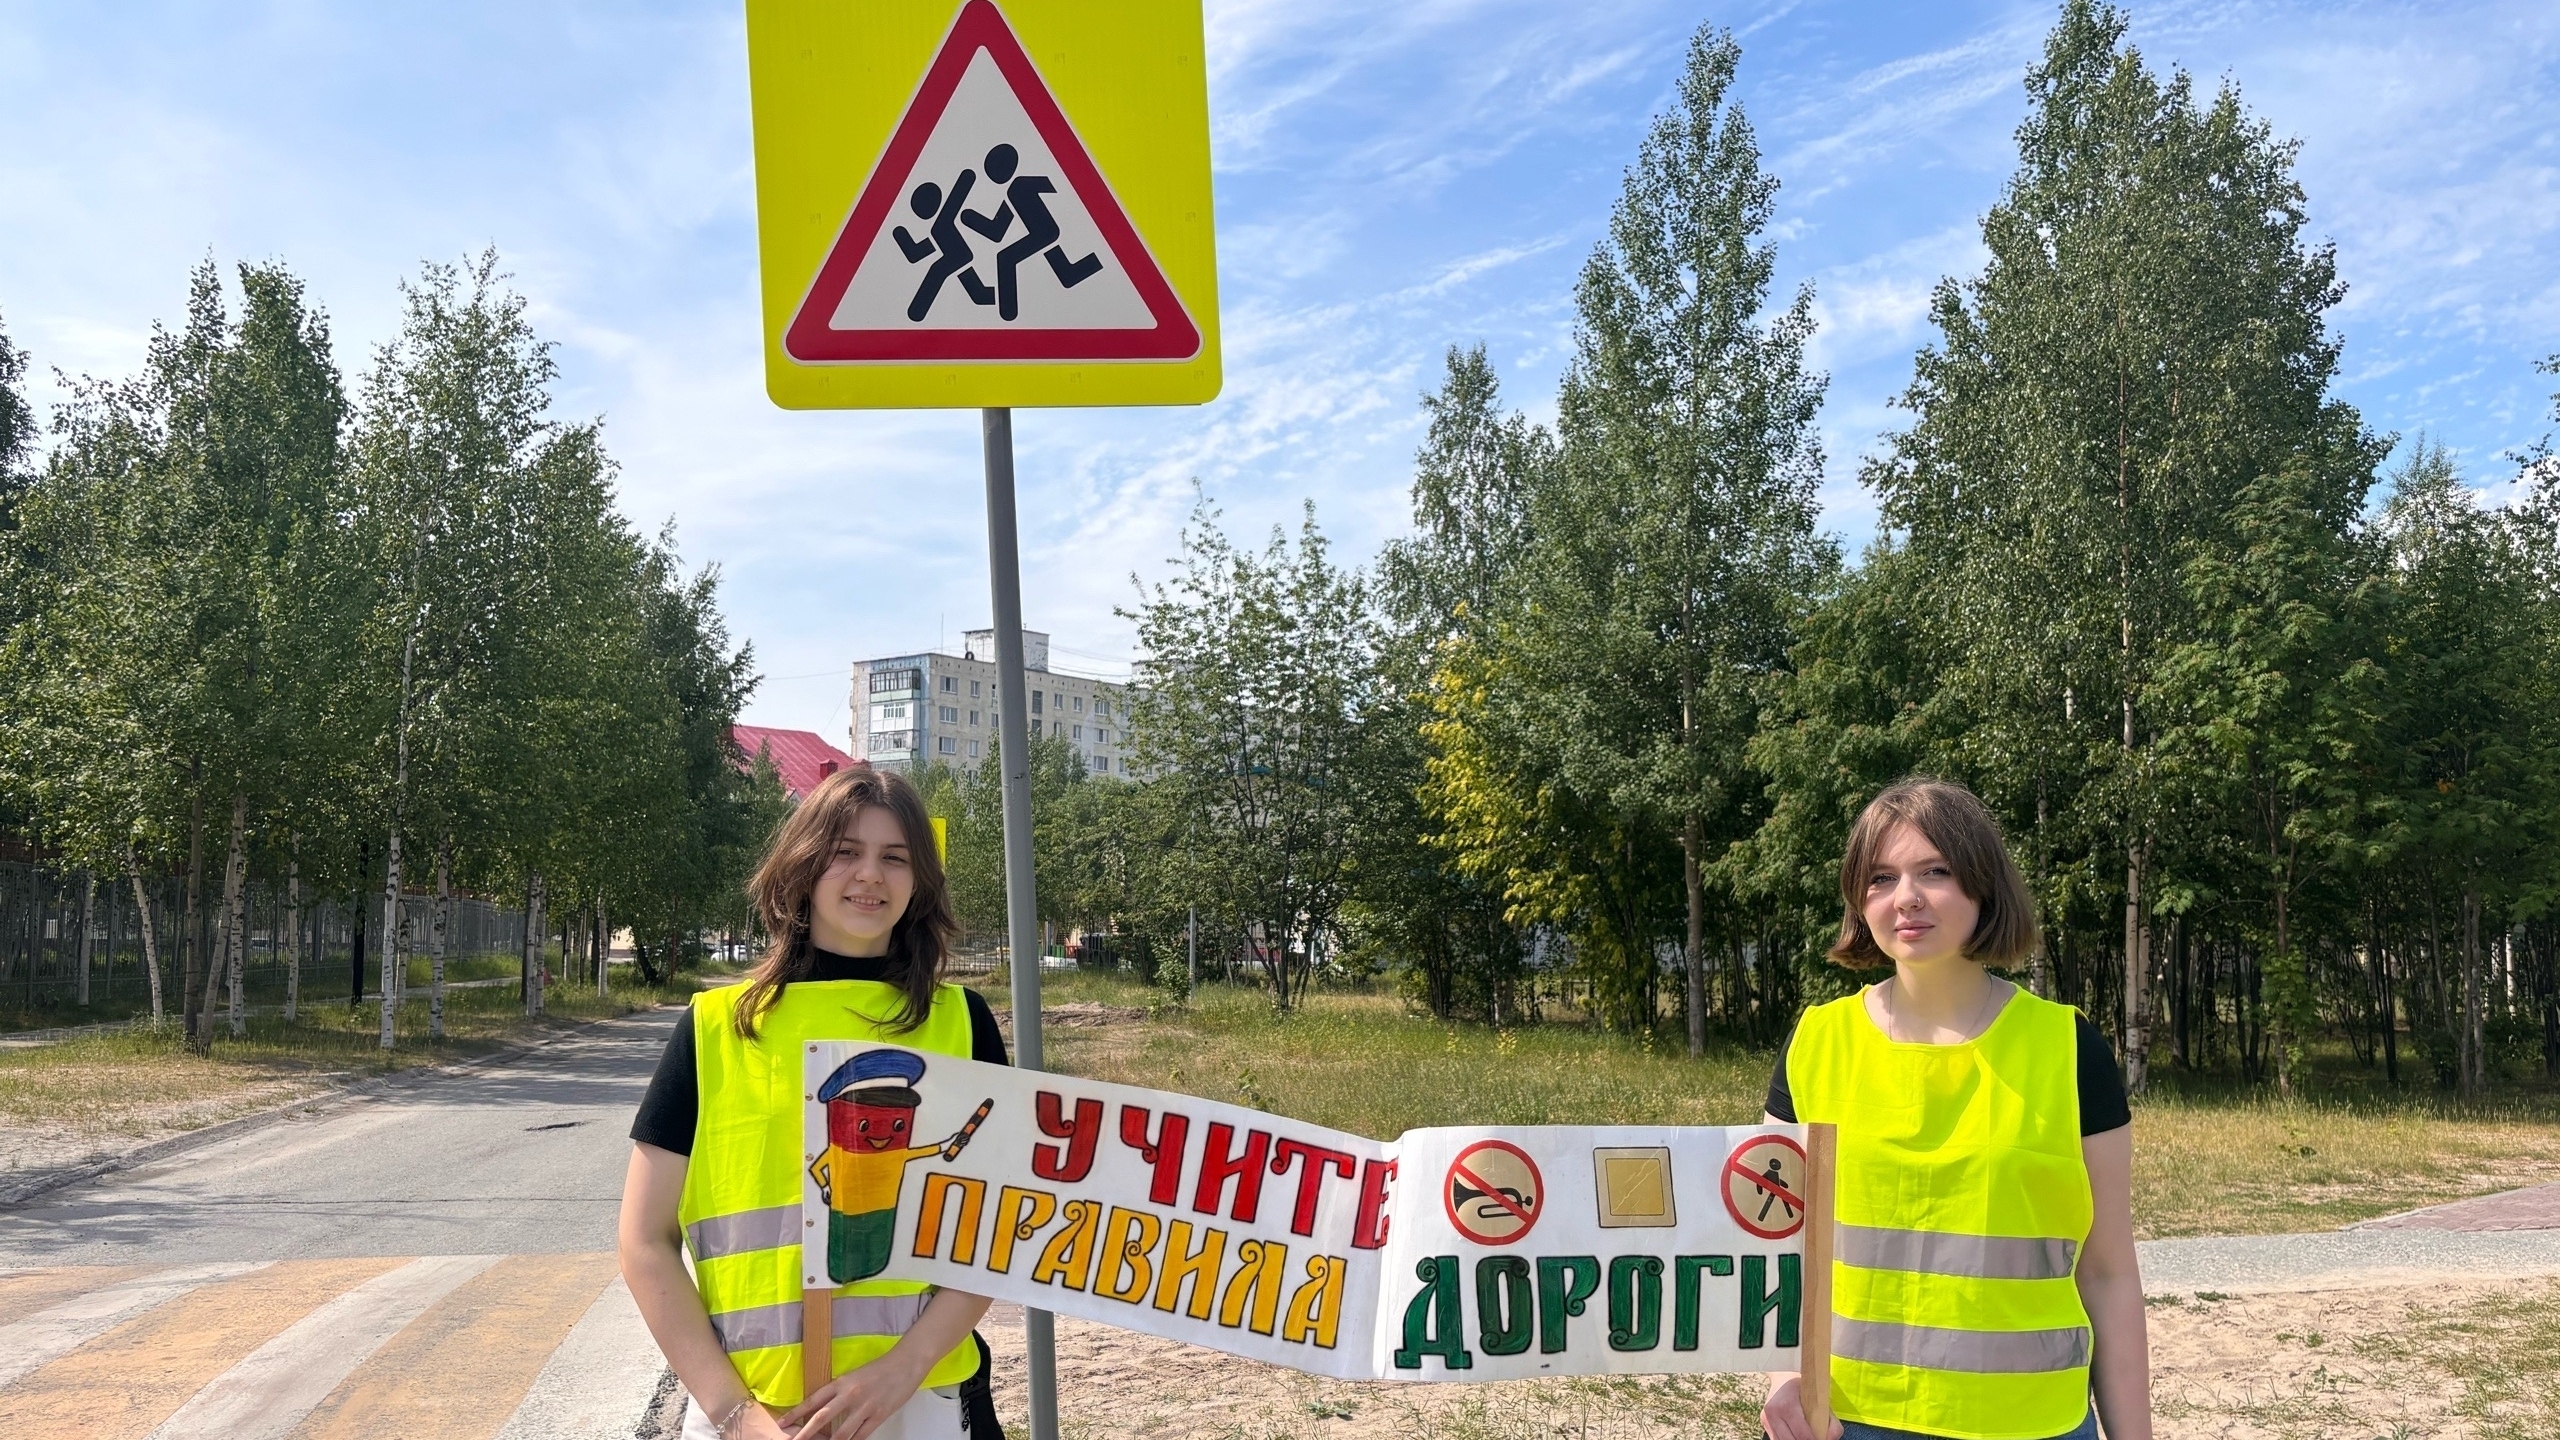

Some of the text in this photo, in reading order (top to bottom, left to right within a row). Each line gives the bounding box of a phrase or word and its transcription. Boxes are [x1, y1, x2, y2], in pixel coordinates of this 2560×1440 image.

[1031, 1090, 1399, 1250] УЧИТЕ
[911, 1172, 1347, 1349] ПРАВИЛА
[1393, 1253, 1801, 1370] ДОРОГИ
